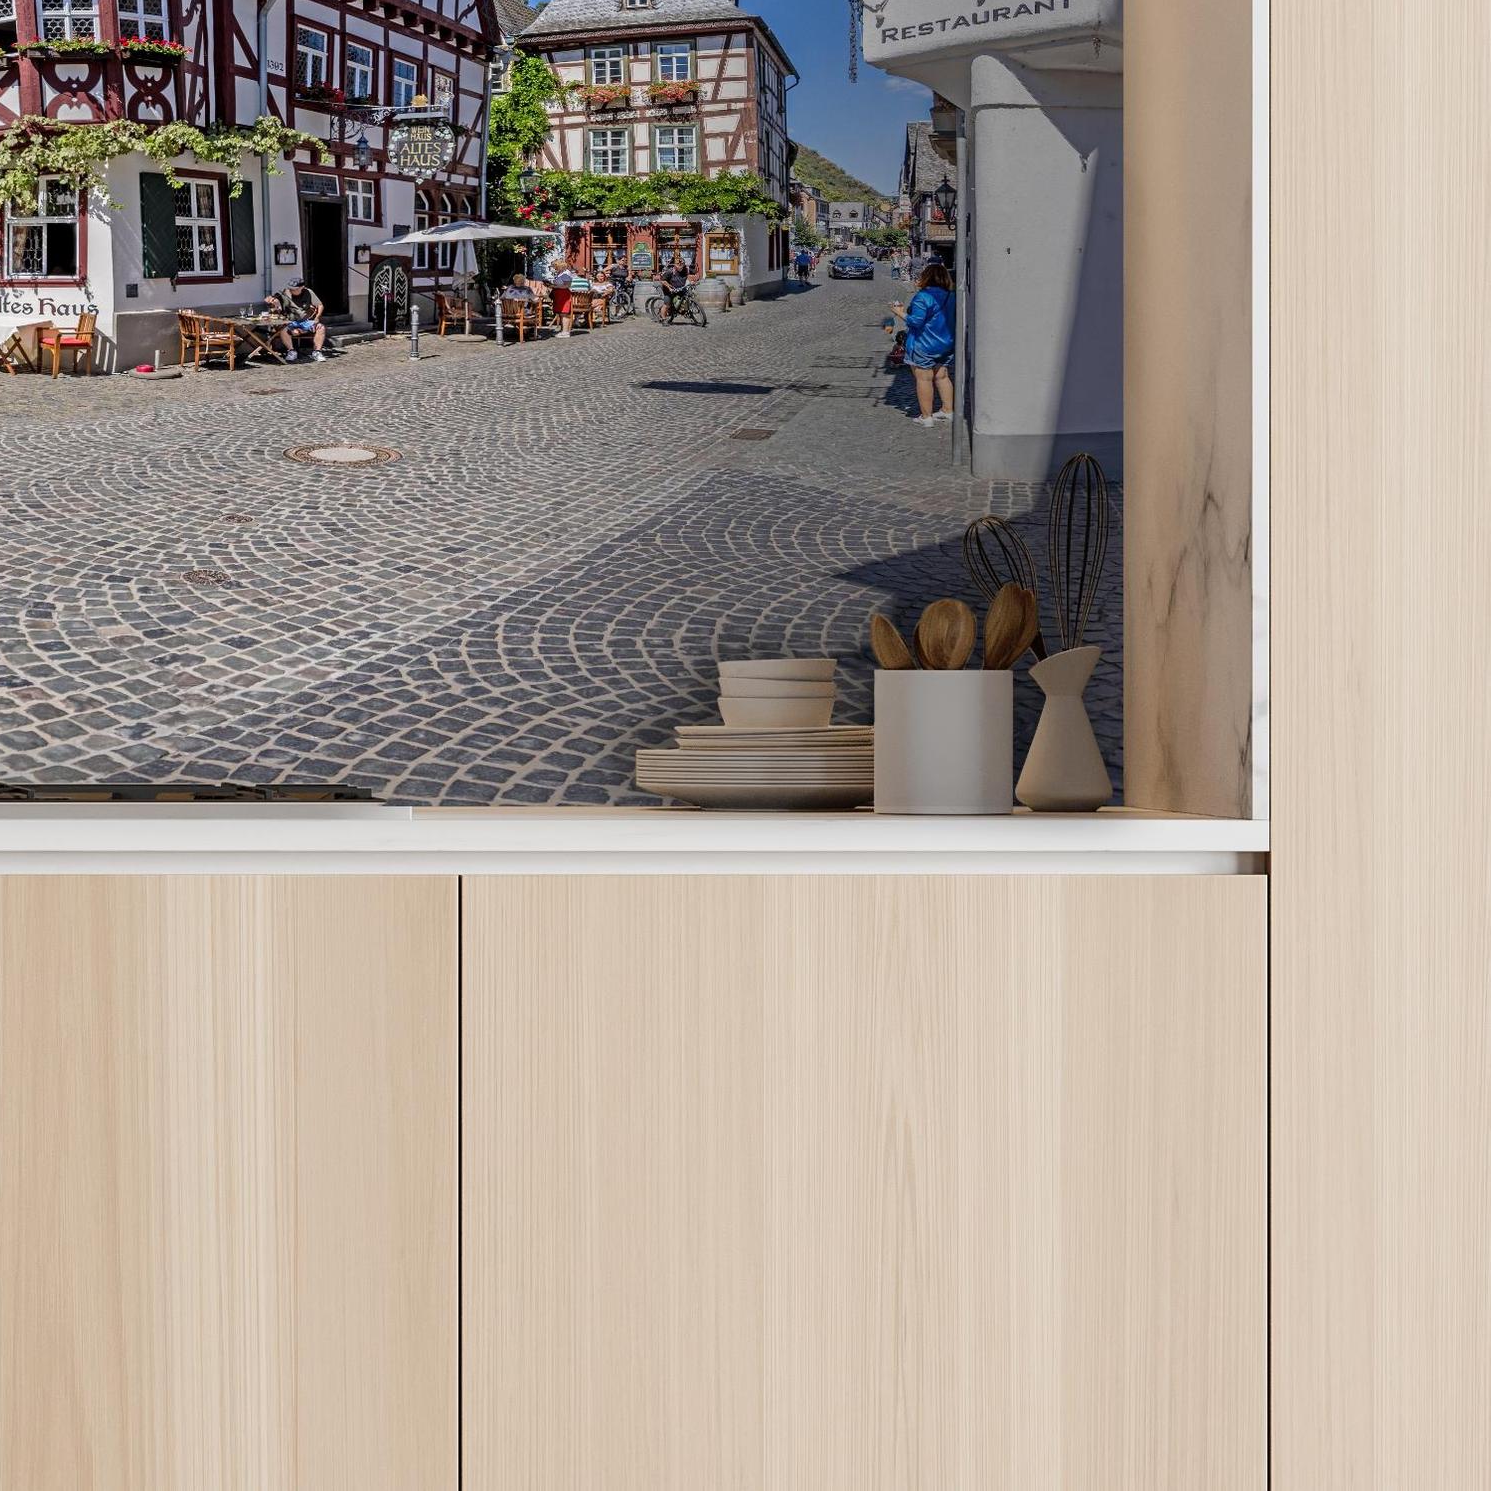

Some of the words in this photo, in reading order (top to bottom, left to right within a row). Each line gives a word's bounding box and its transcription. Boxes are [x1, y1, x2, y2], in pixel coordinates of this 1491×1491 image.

[410, 126, 431, 134] WEIN
[400, 142, 442, 155] ALTES
[400, 154, 441, 167] HAUS
[38, 297, 100, 316] Haus
